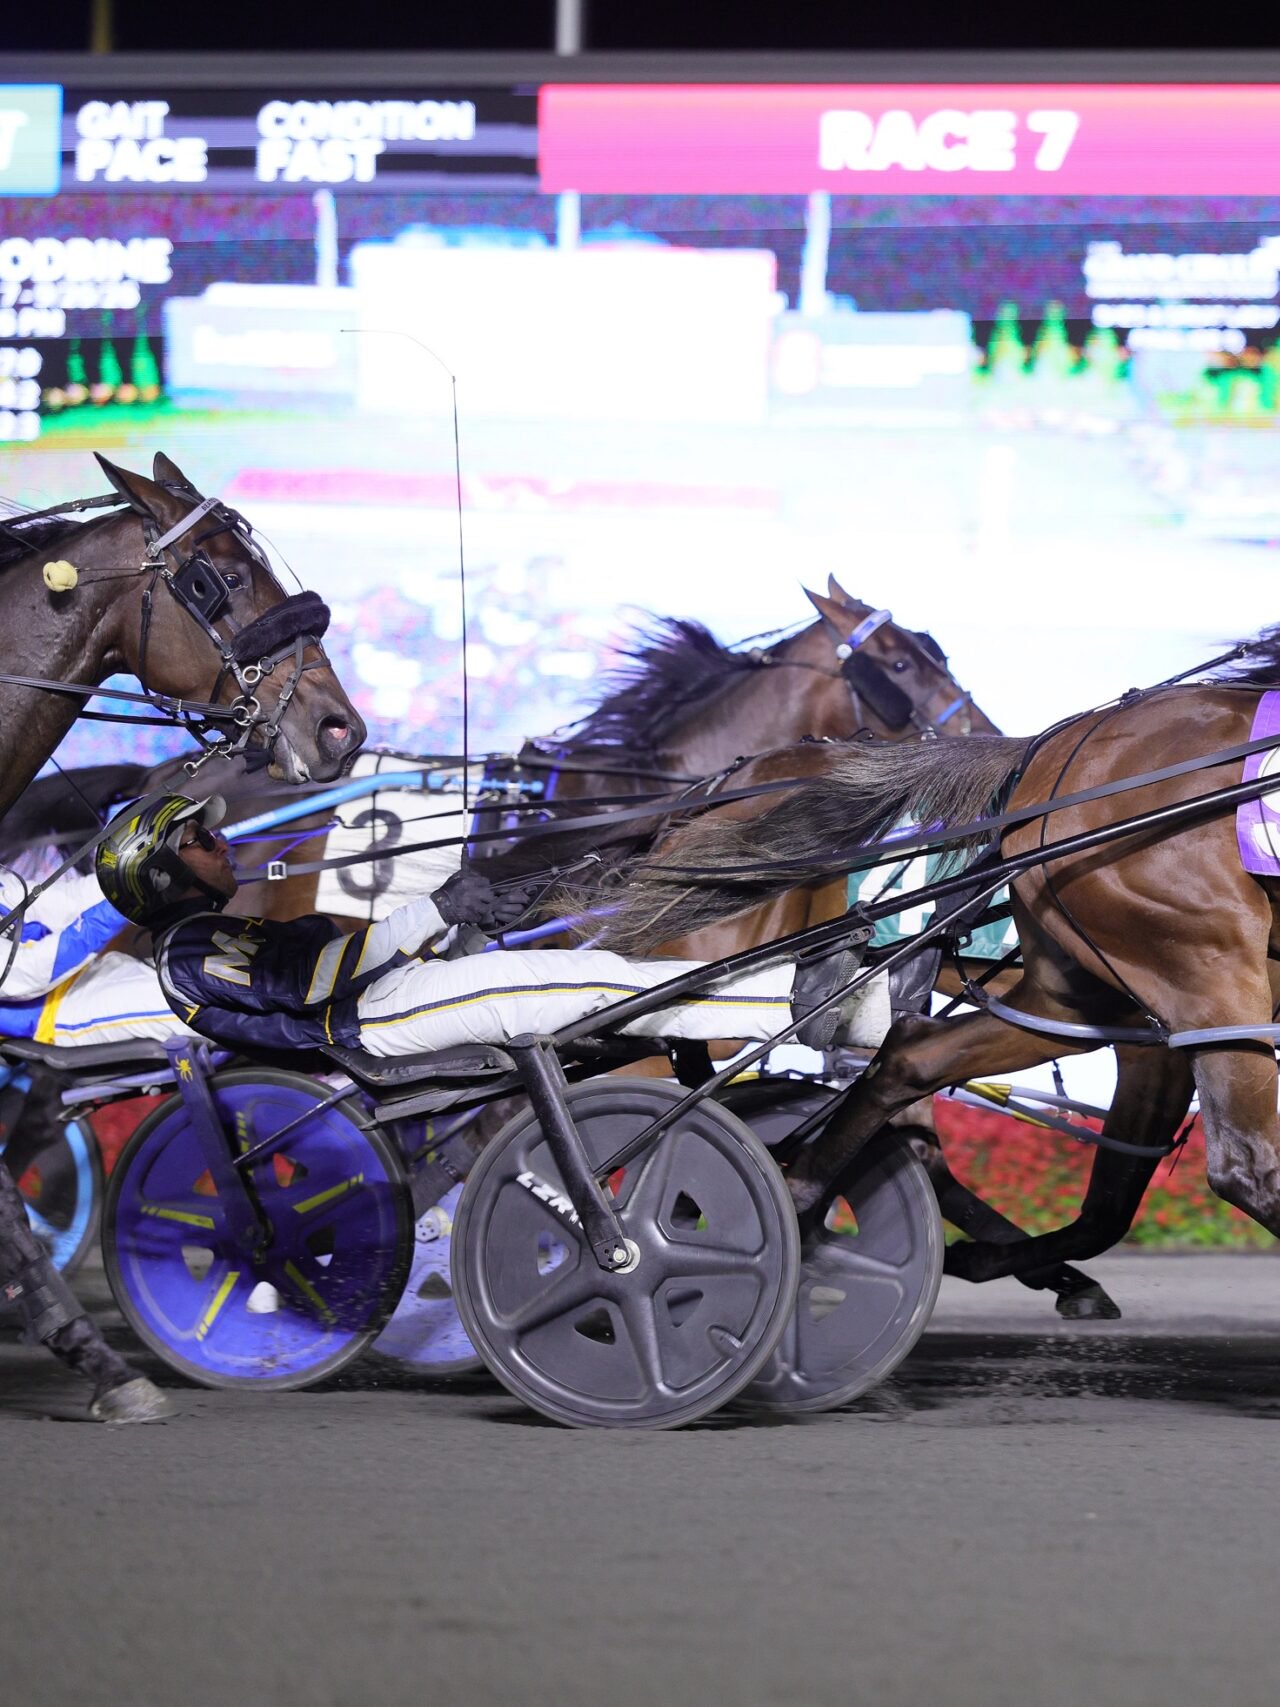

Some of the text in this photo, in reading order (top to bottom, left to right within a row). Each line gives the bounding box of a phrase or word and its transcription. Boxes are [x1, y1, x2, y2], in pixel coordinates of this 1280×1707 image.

[77, 101, 169, 139] GAIT
[258, 101, 474, 140] CONDITION
[820, 109, 1079, 171] RACE 7
[76, 138, 207, 182] PACE
[258, 139, 384, 182] FAST
[336, 808, 403, 901] 3
